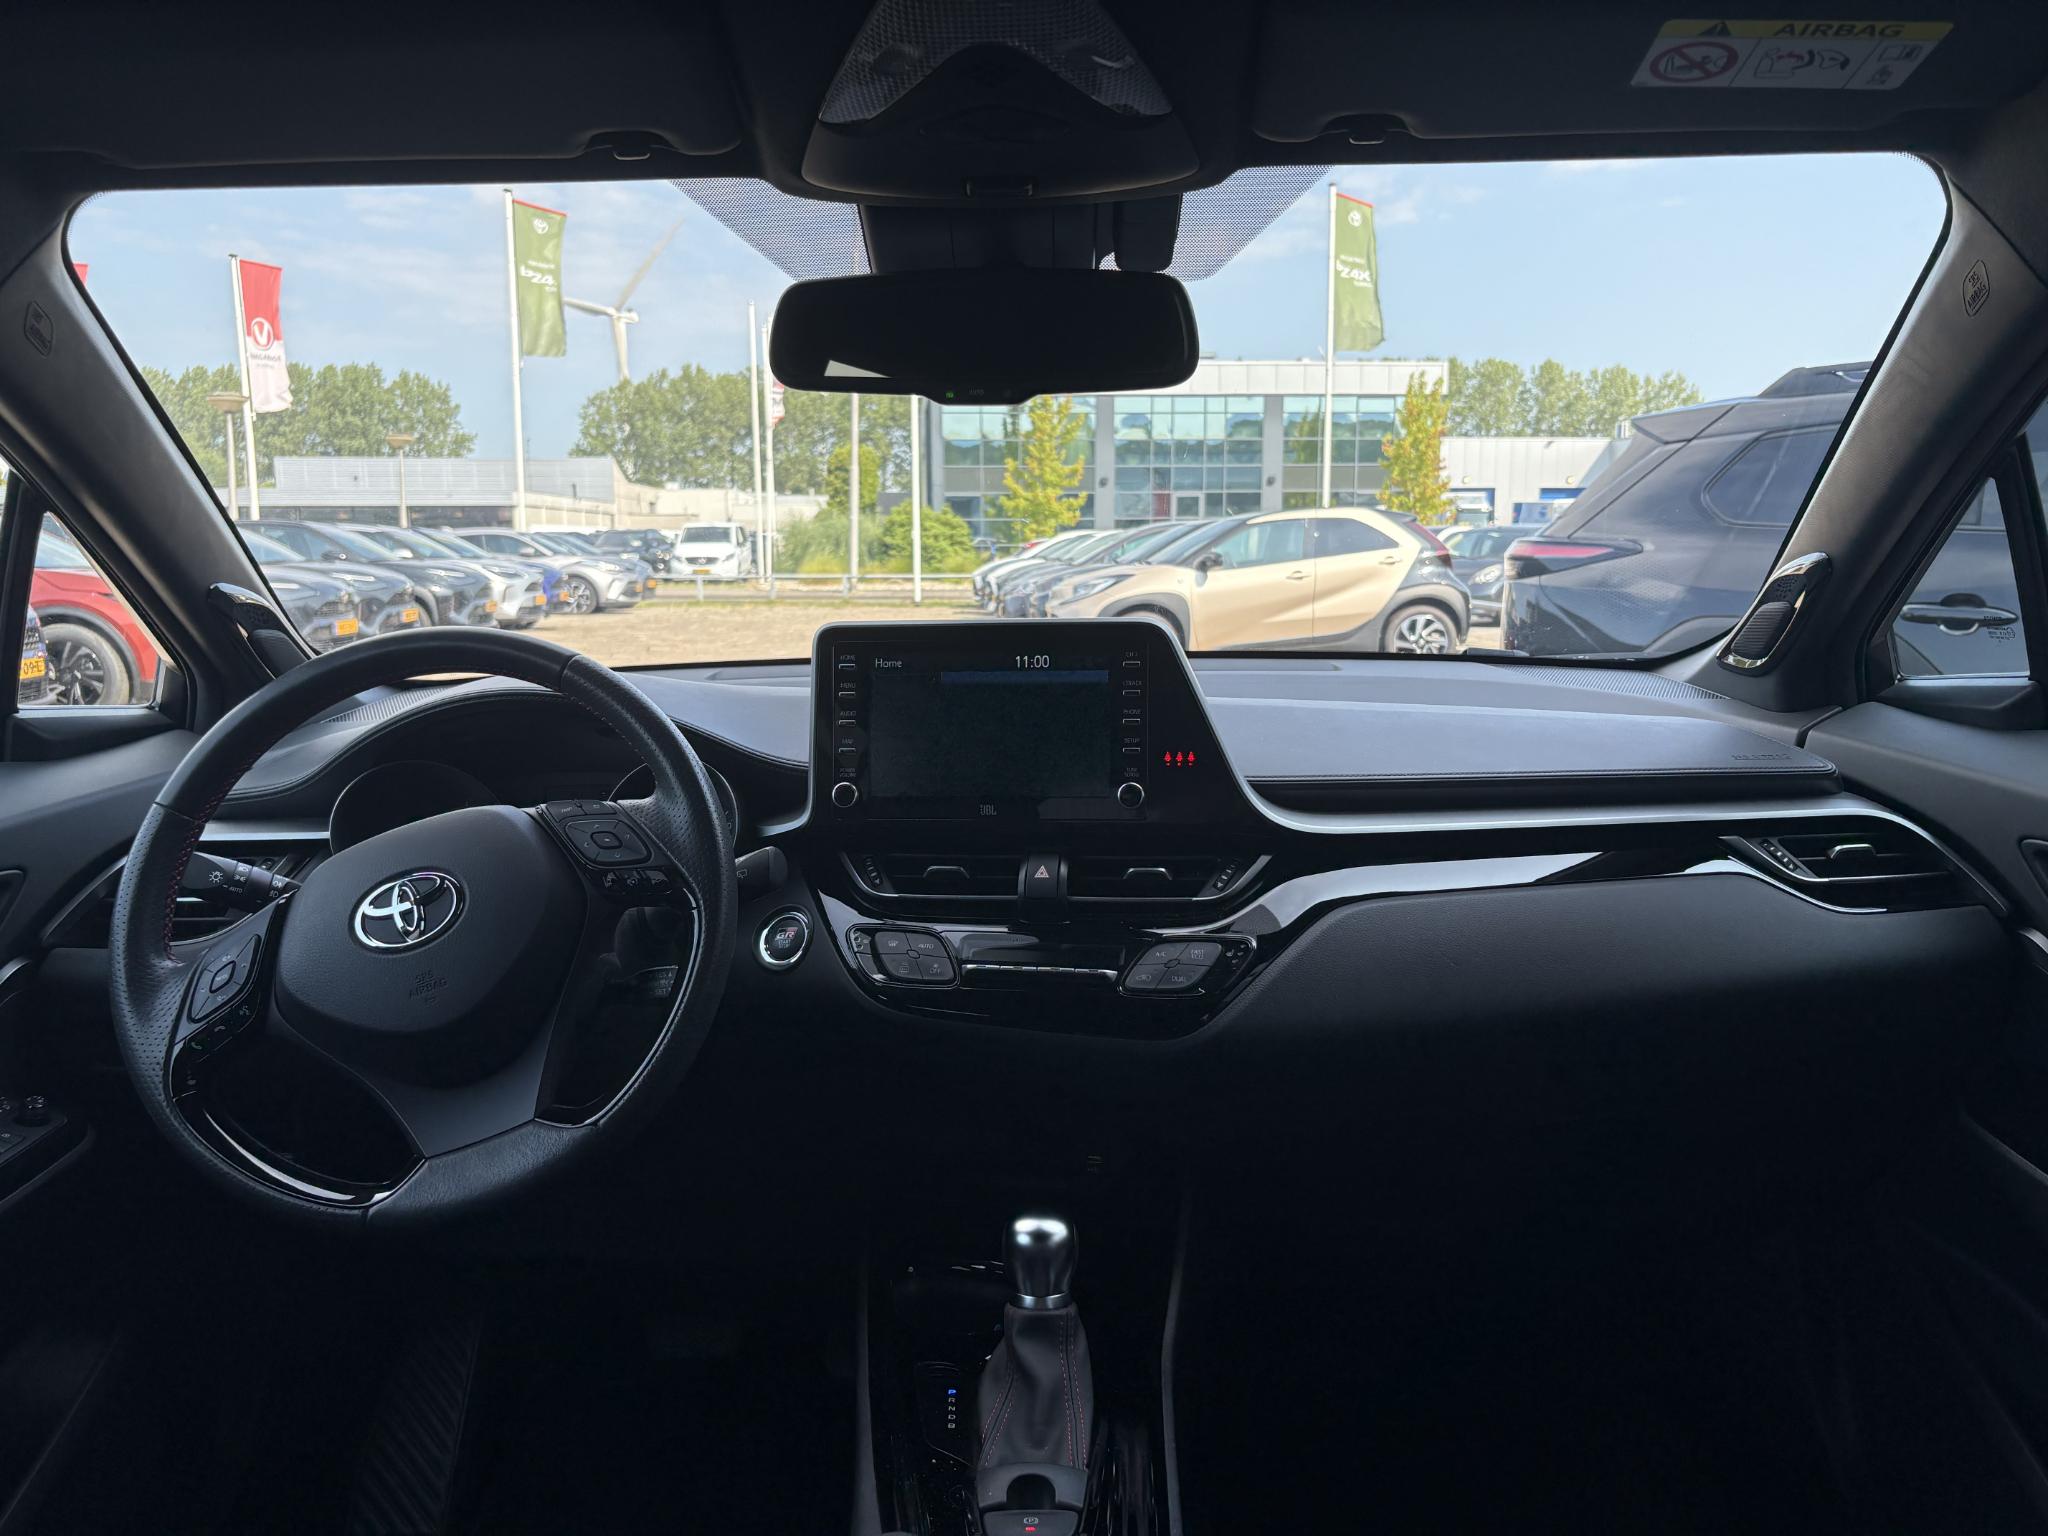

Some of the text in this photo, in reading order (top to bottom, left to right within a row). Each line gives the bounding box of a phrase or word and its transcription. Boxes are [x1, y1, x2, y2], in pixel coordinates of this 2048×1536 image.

[1773, 23, 1904, 37] AIRBAG
[875, 657, 903, 668] Home
[1014, 654, 1050, 669] 11:00
[980, 804, 998, 816] JBL
[776, 931, 796, 939] GR
